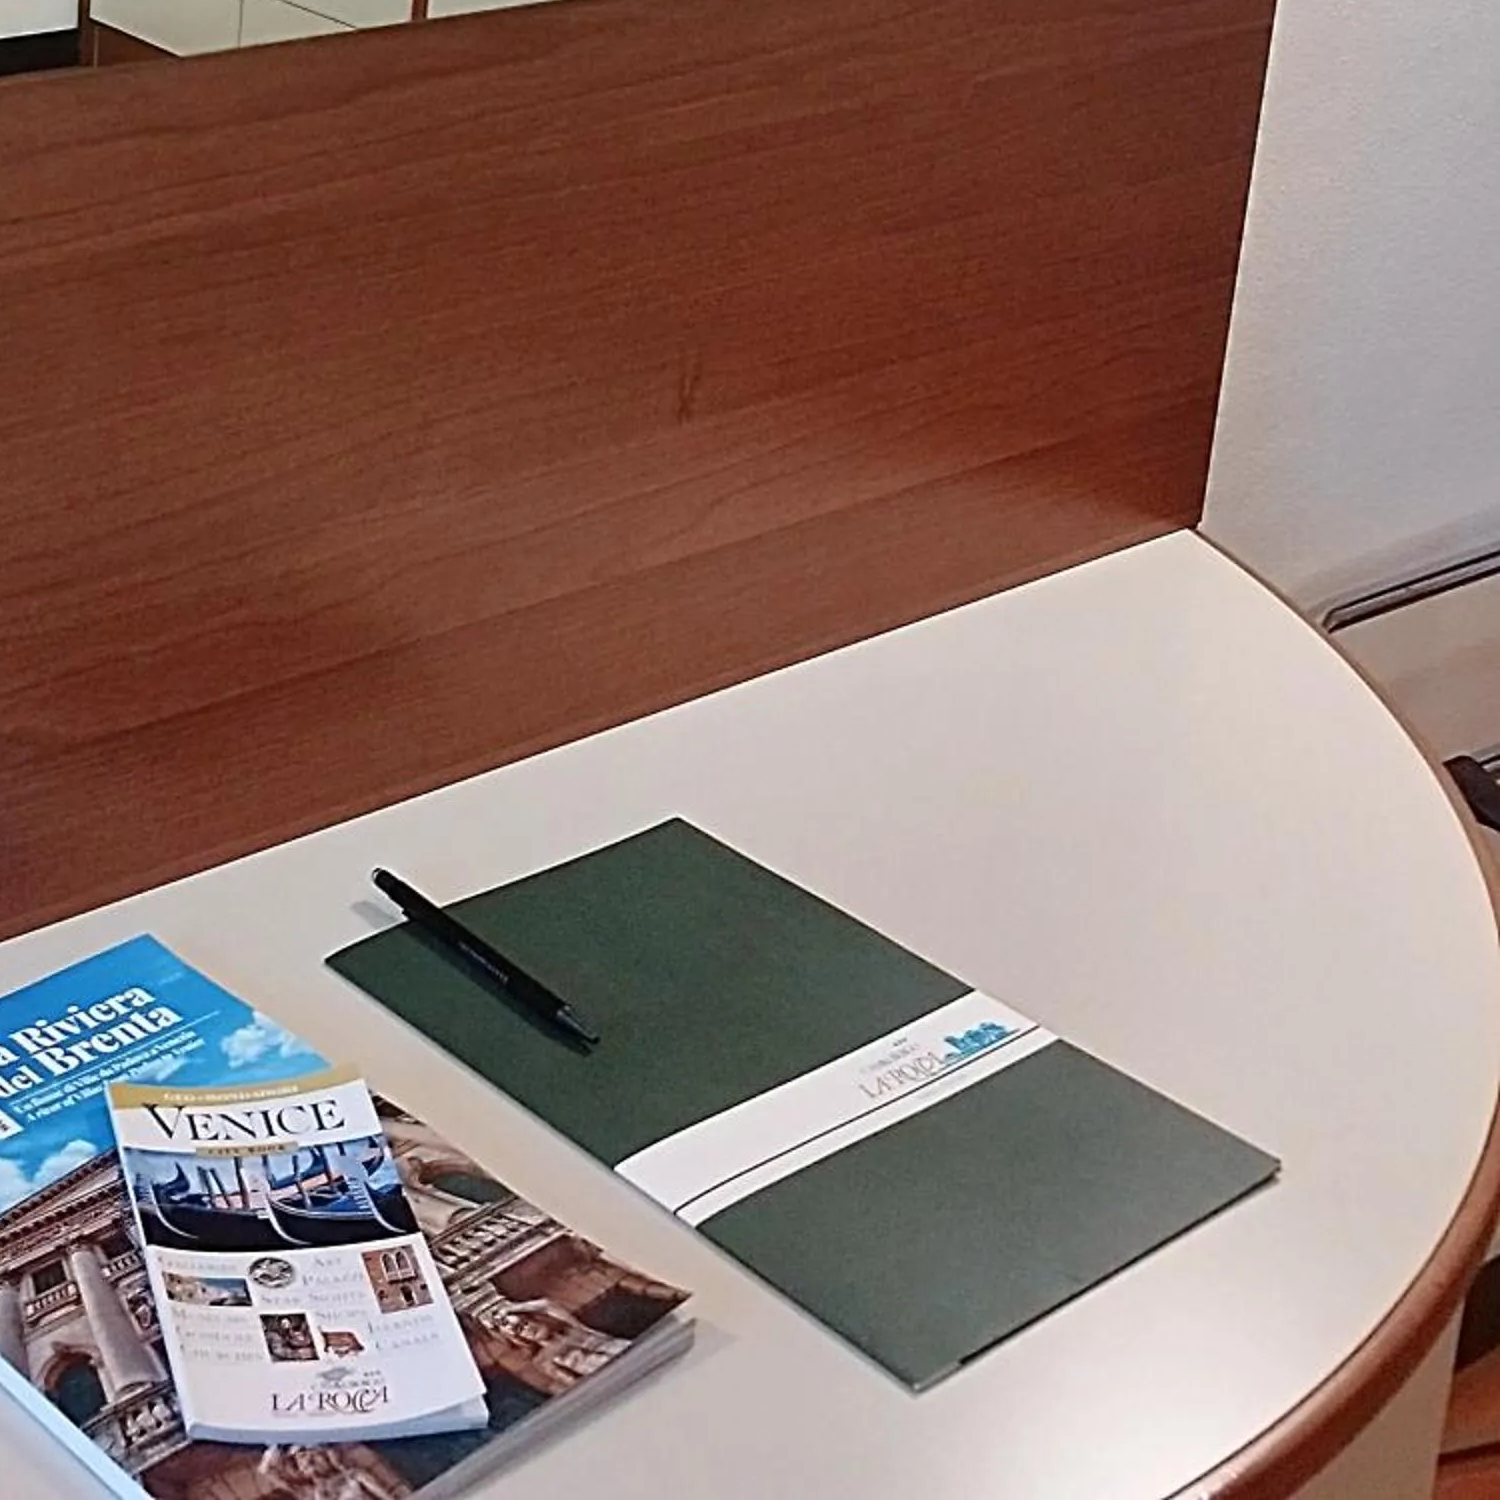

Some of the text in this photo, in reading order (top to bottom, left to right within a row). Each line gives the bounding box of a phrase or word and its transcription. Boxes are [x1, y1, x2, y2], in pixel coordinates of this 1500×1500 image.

[8, 987, 156, 1054] Riviera
[31, 1006, 183, 1076] Brenta
[142, 1099, 345, 1140] VENICE
[272, 1393, 305, 1411] LA
